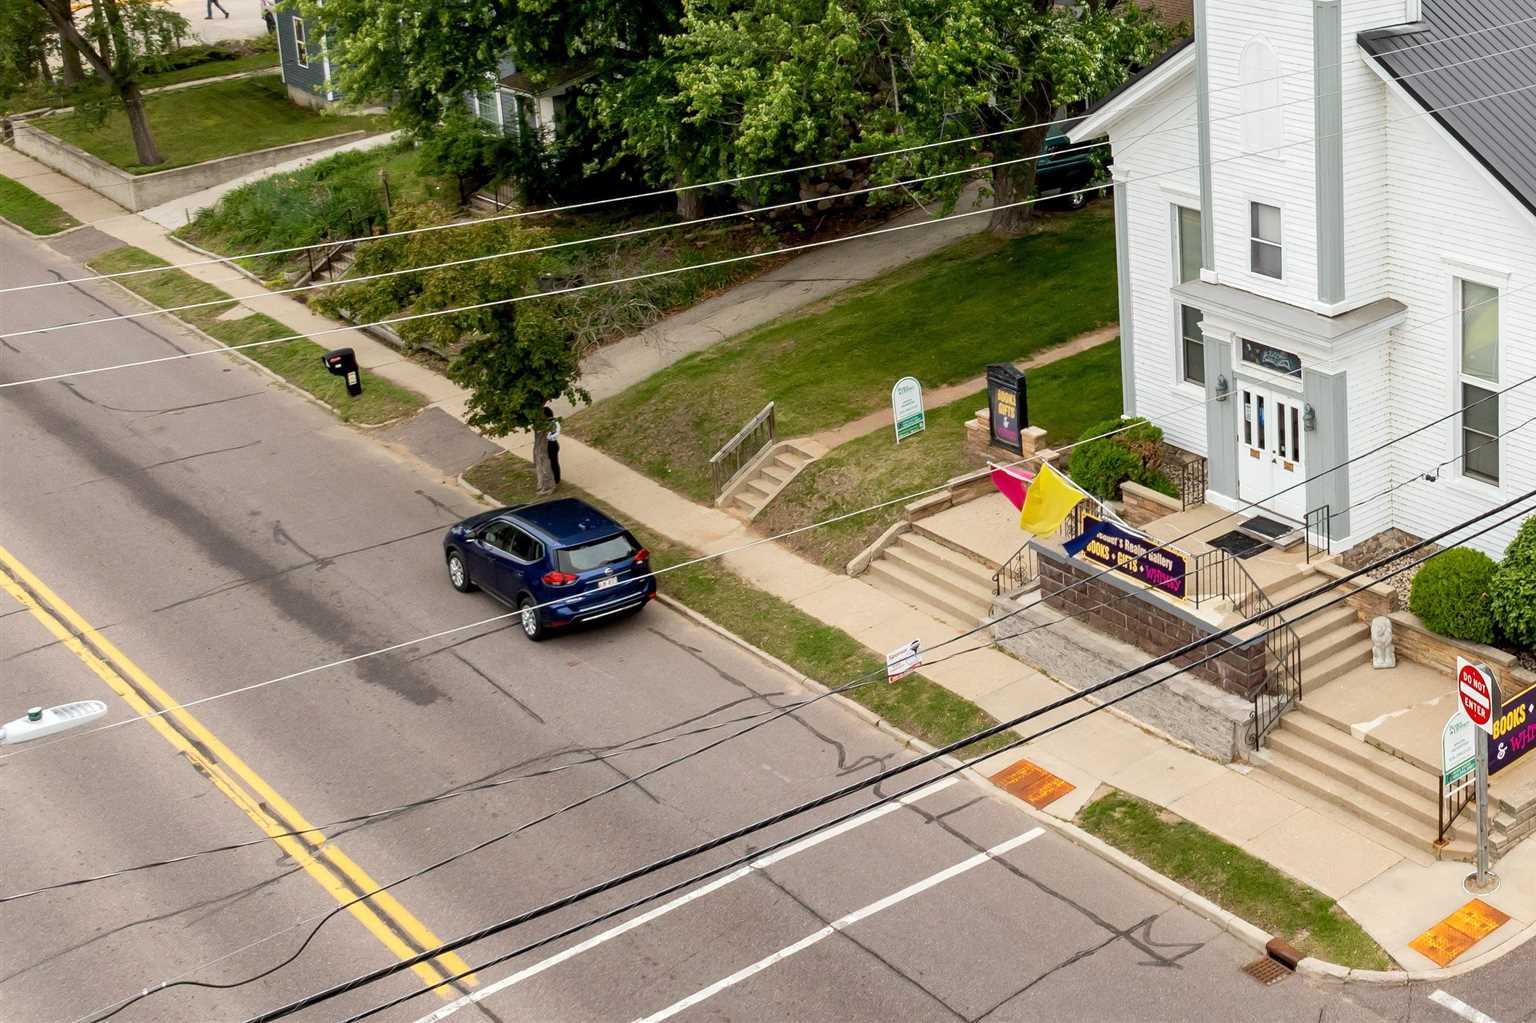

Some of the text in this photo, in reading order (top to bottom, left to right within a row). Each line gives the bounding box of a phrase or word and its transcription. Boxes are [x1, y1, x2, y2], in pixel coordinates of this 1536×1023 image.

[1087, 539, 1110, 560] BOOKS
[1117, 551, 1138, 573] GIFTS
[1463, 671, 1486, 693] DO NOT
[1464, 698, 1486, 719] ENTER
[1492, 703, 1526, 740] BOOKS
[1497, 742, 1508, 760] &
